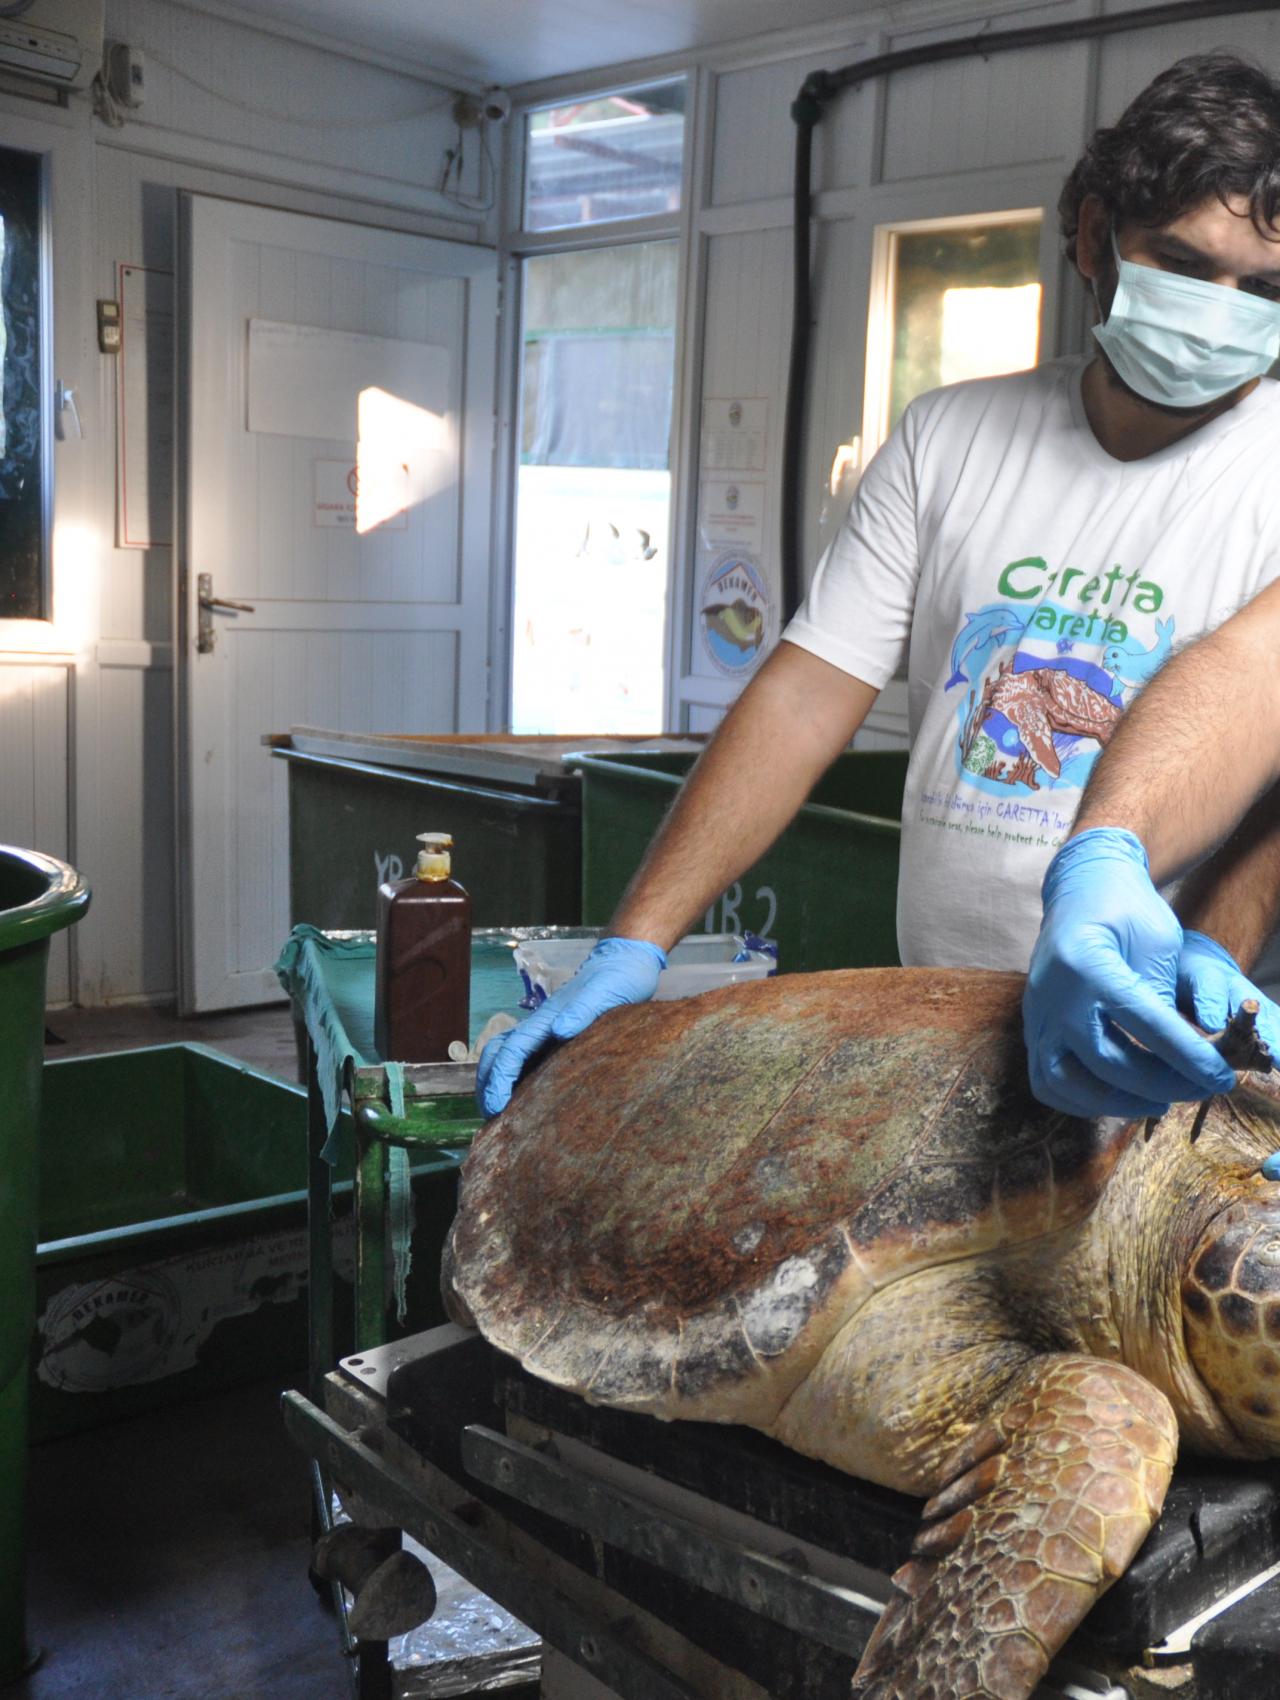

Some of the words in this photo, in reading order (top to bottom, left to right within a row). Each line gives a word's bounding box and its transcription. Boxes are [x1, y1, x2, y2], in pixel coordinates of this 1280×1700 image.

[998, 555, 1164, 614] Cretta
[1028, 605, 1129, 643] aretta
[756, 886, 778, 938] 2
